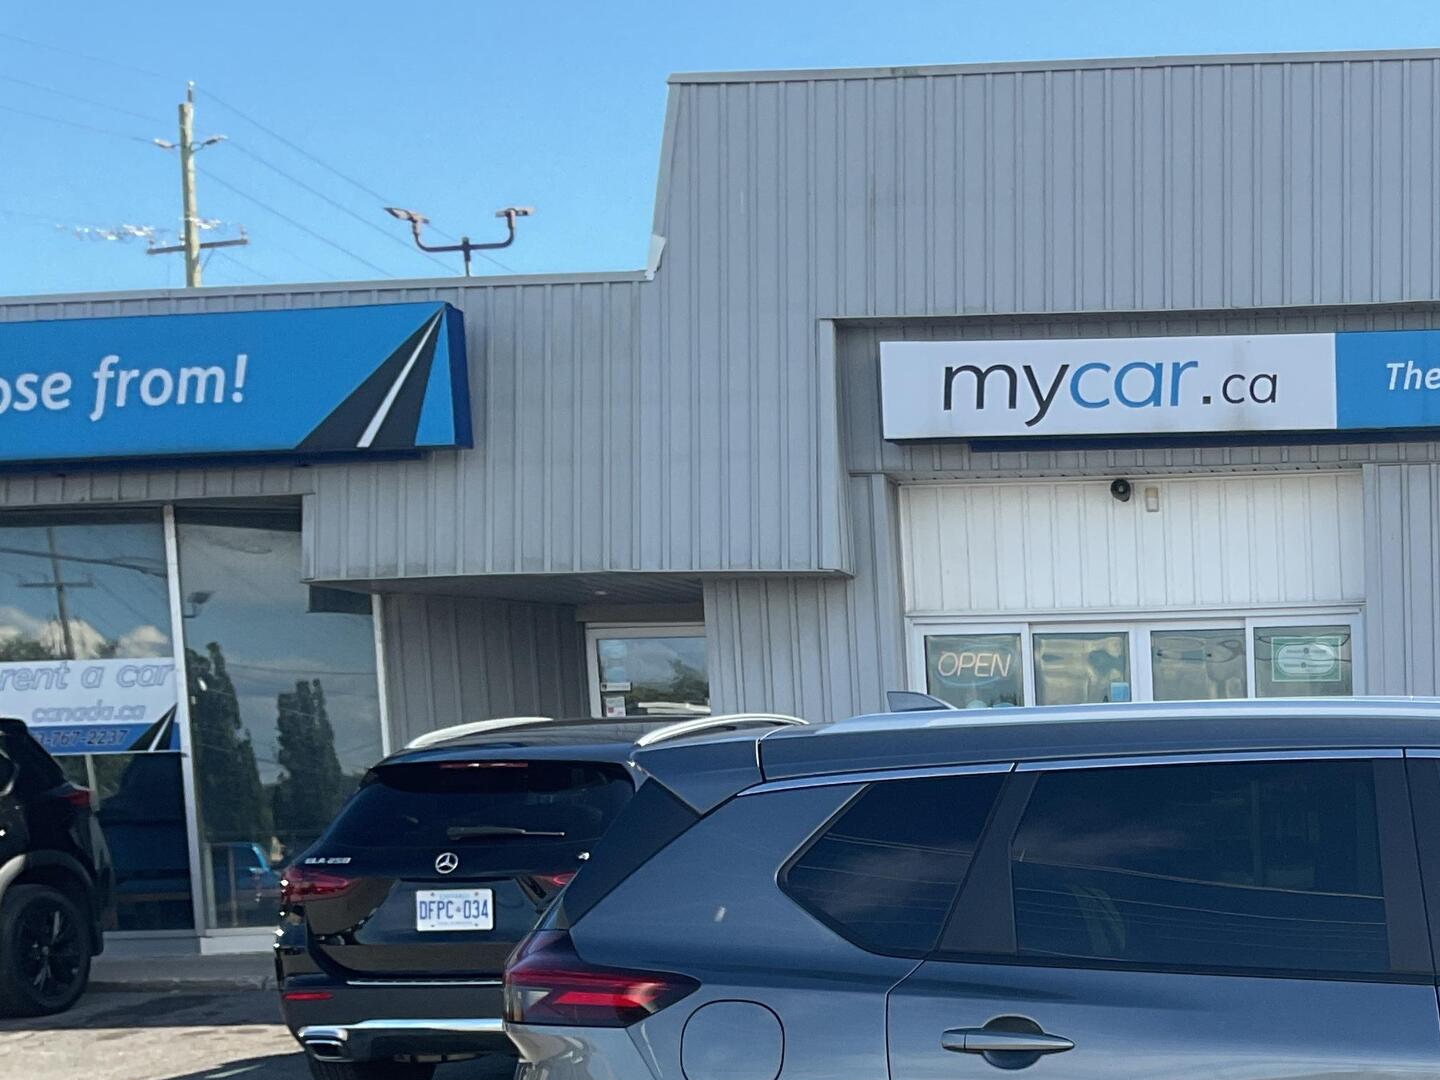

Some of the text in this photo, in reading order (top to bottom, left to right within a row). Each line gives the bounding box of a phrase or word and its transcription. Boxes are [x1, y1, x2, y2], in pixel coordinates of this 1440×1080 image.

[89, 354, 248, 422] from!
[943, 361, 1278, 427] mycar.ca
[0, 661, 175, 692] rent a car
[937, 651, 1012, 678] OPEN
[32, 700, 146, 722] canada.ca
